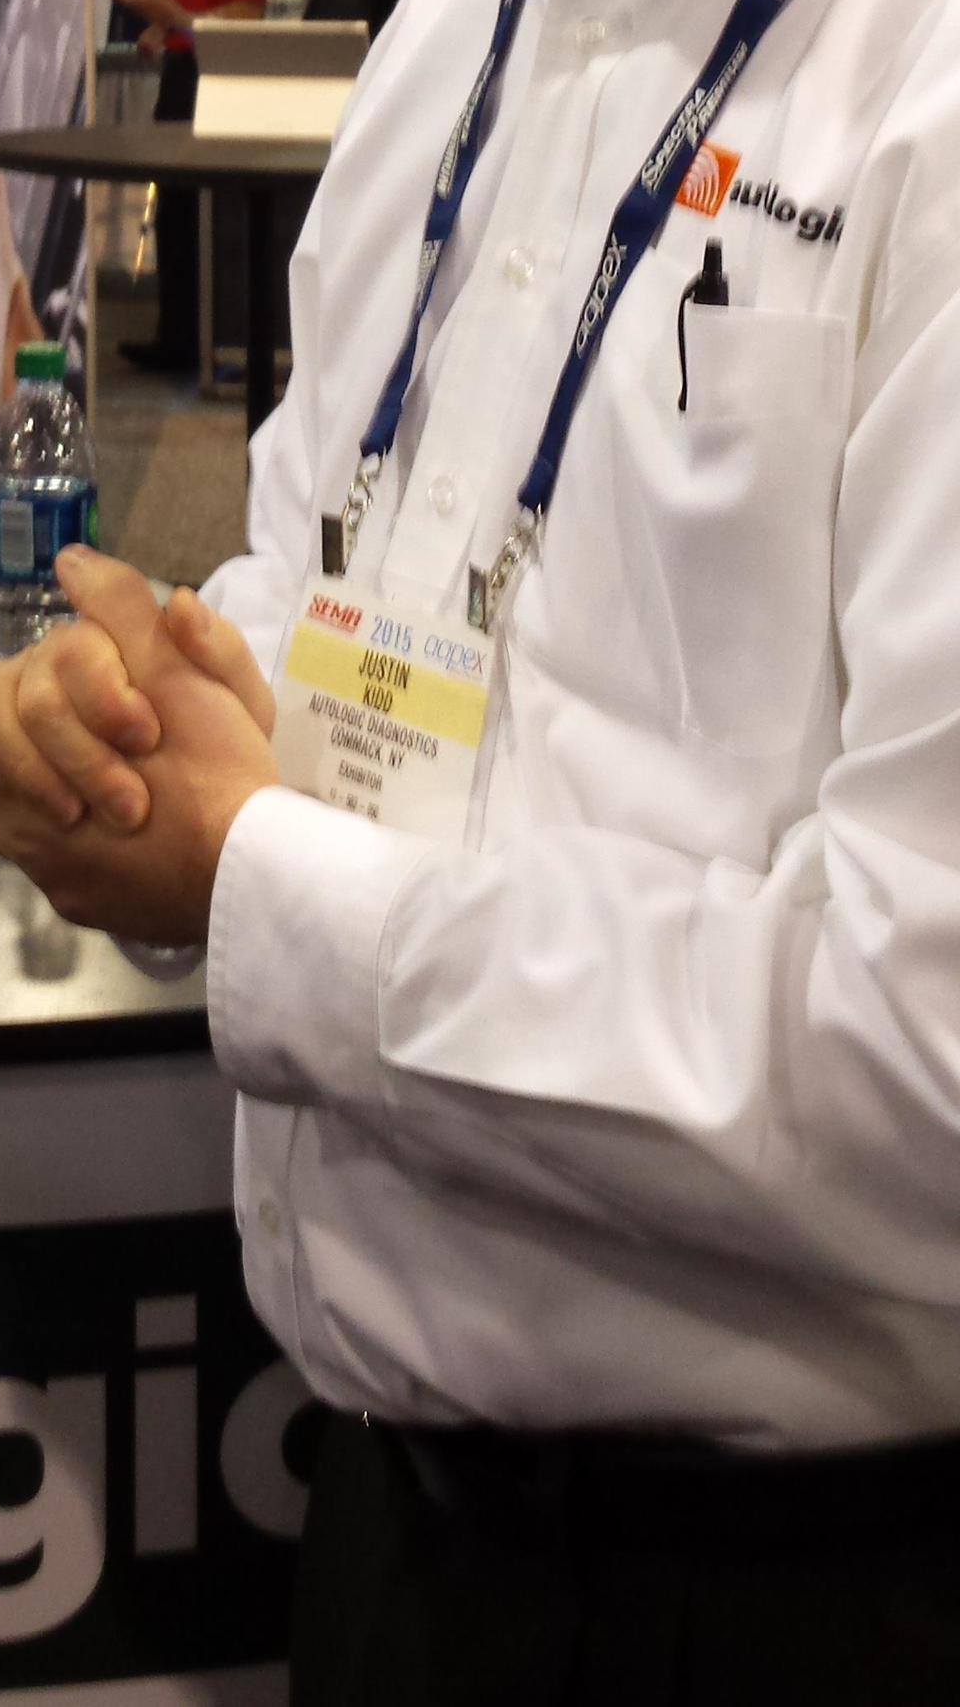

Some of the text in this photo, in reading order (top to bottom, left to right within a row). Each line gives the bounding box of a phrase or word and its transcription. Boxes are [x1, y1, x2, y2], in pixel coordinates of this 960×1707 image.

[576, 232, 628, 360] aapex
[371, 614, 414, 655] 2015
[423, 634, 487, 674] aapex
[359, 648, 411, 690] JUSTIN
[362, 683, 394, 715] KIDD
[308, 691, 439, 759] AUTOLOGIC DIAGNOSTICS
[330, 724, 406, 770] COMMACK, NY
[338, 759, 383, 792] EXHIBITOR
